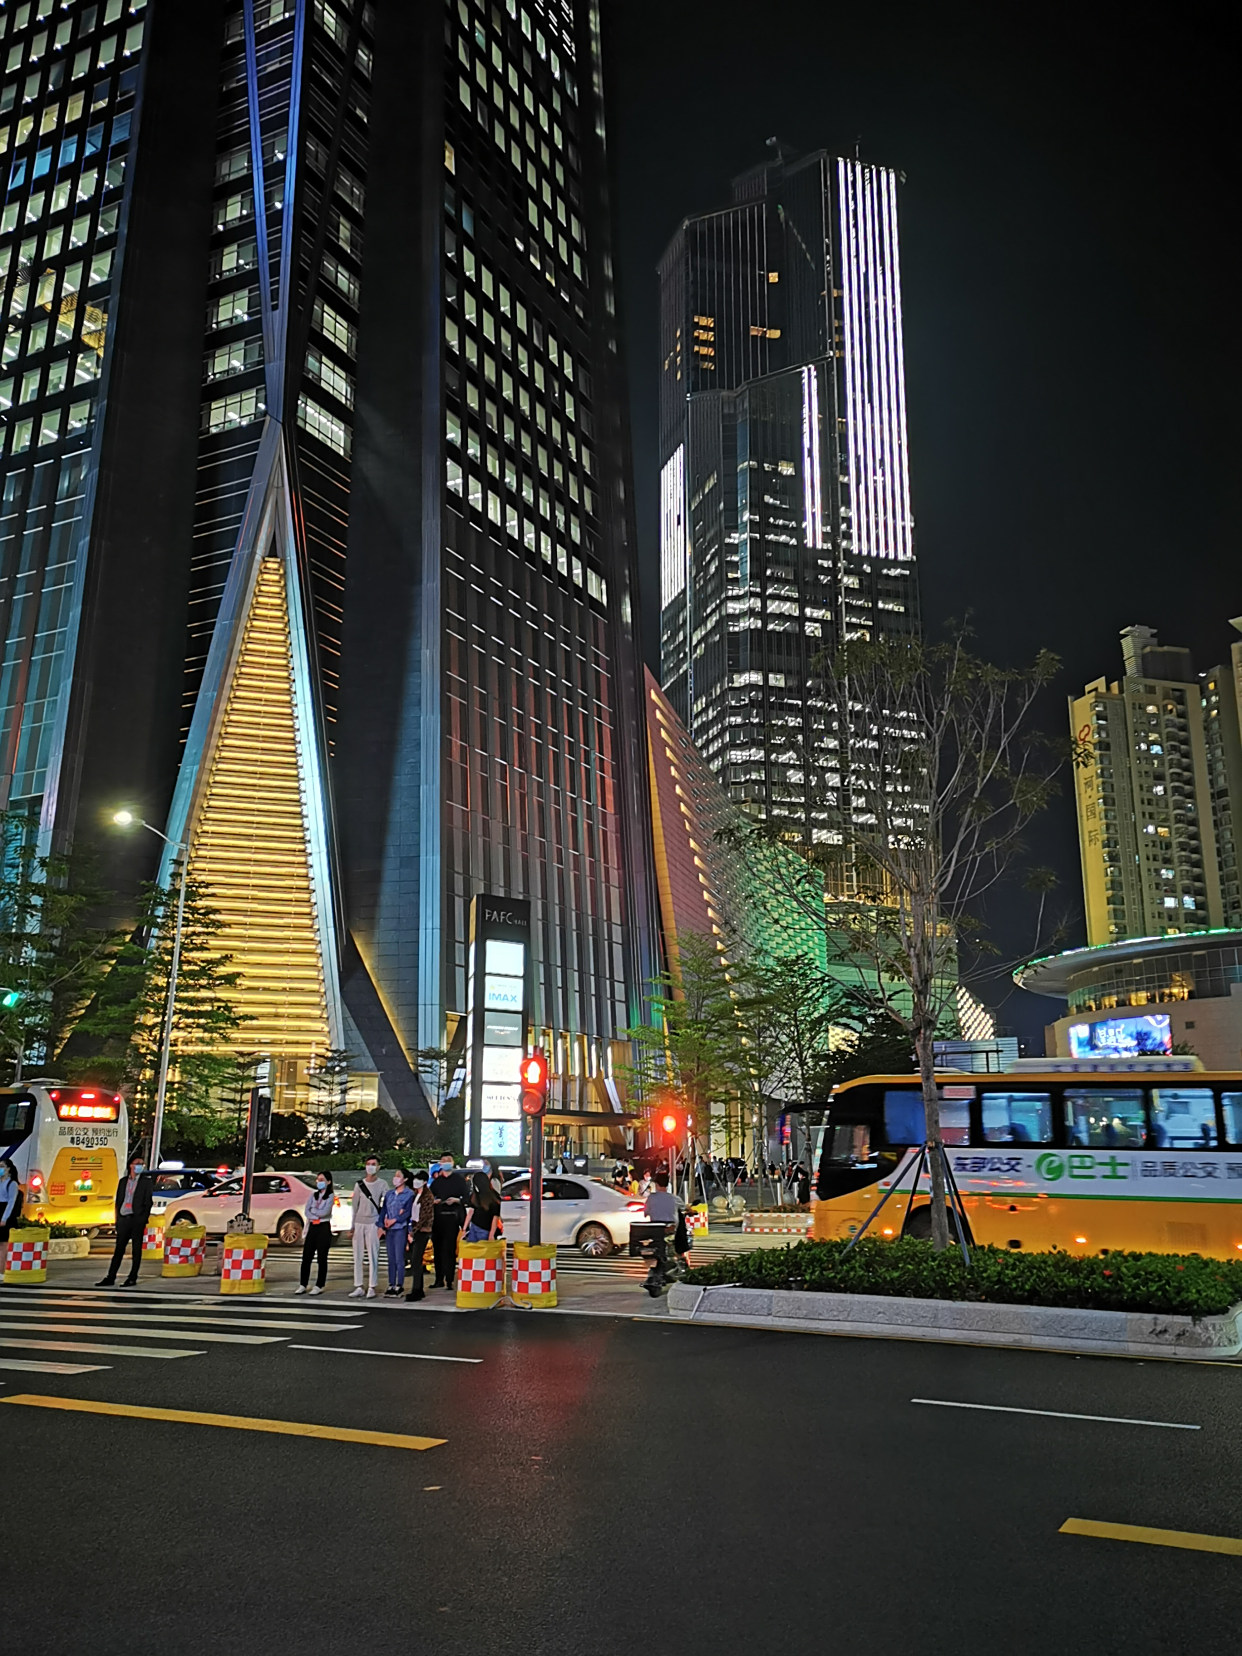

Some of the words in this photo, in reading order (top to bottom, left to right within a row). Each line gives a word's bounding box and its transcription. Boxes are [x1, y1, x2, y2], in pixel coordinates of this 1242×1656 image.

[488, 992, 518, 1003] IMAX
[58, 1126, 90, 1137] 品质公交
[91, 1127, 119, 1138] 预约出行
[1140, 1160, 1221, 1178] 品质公交
